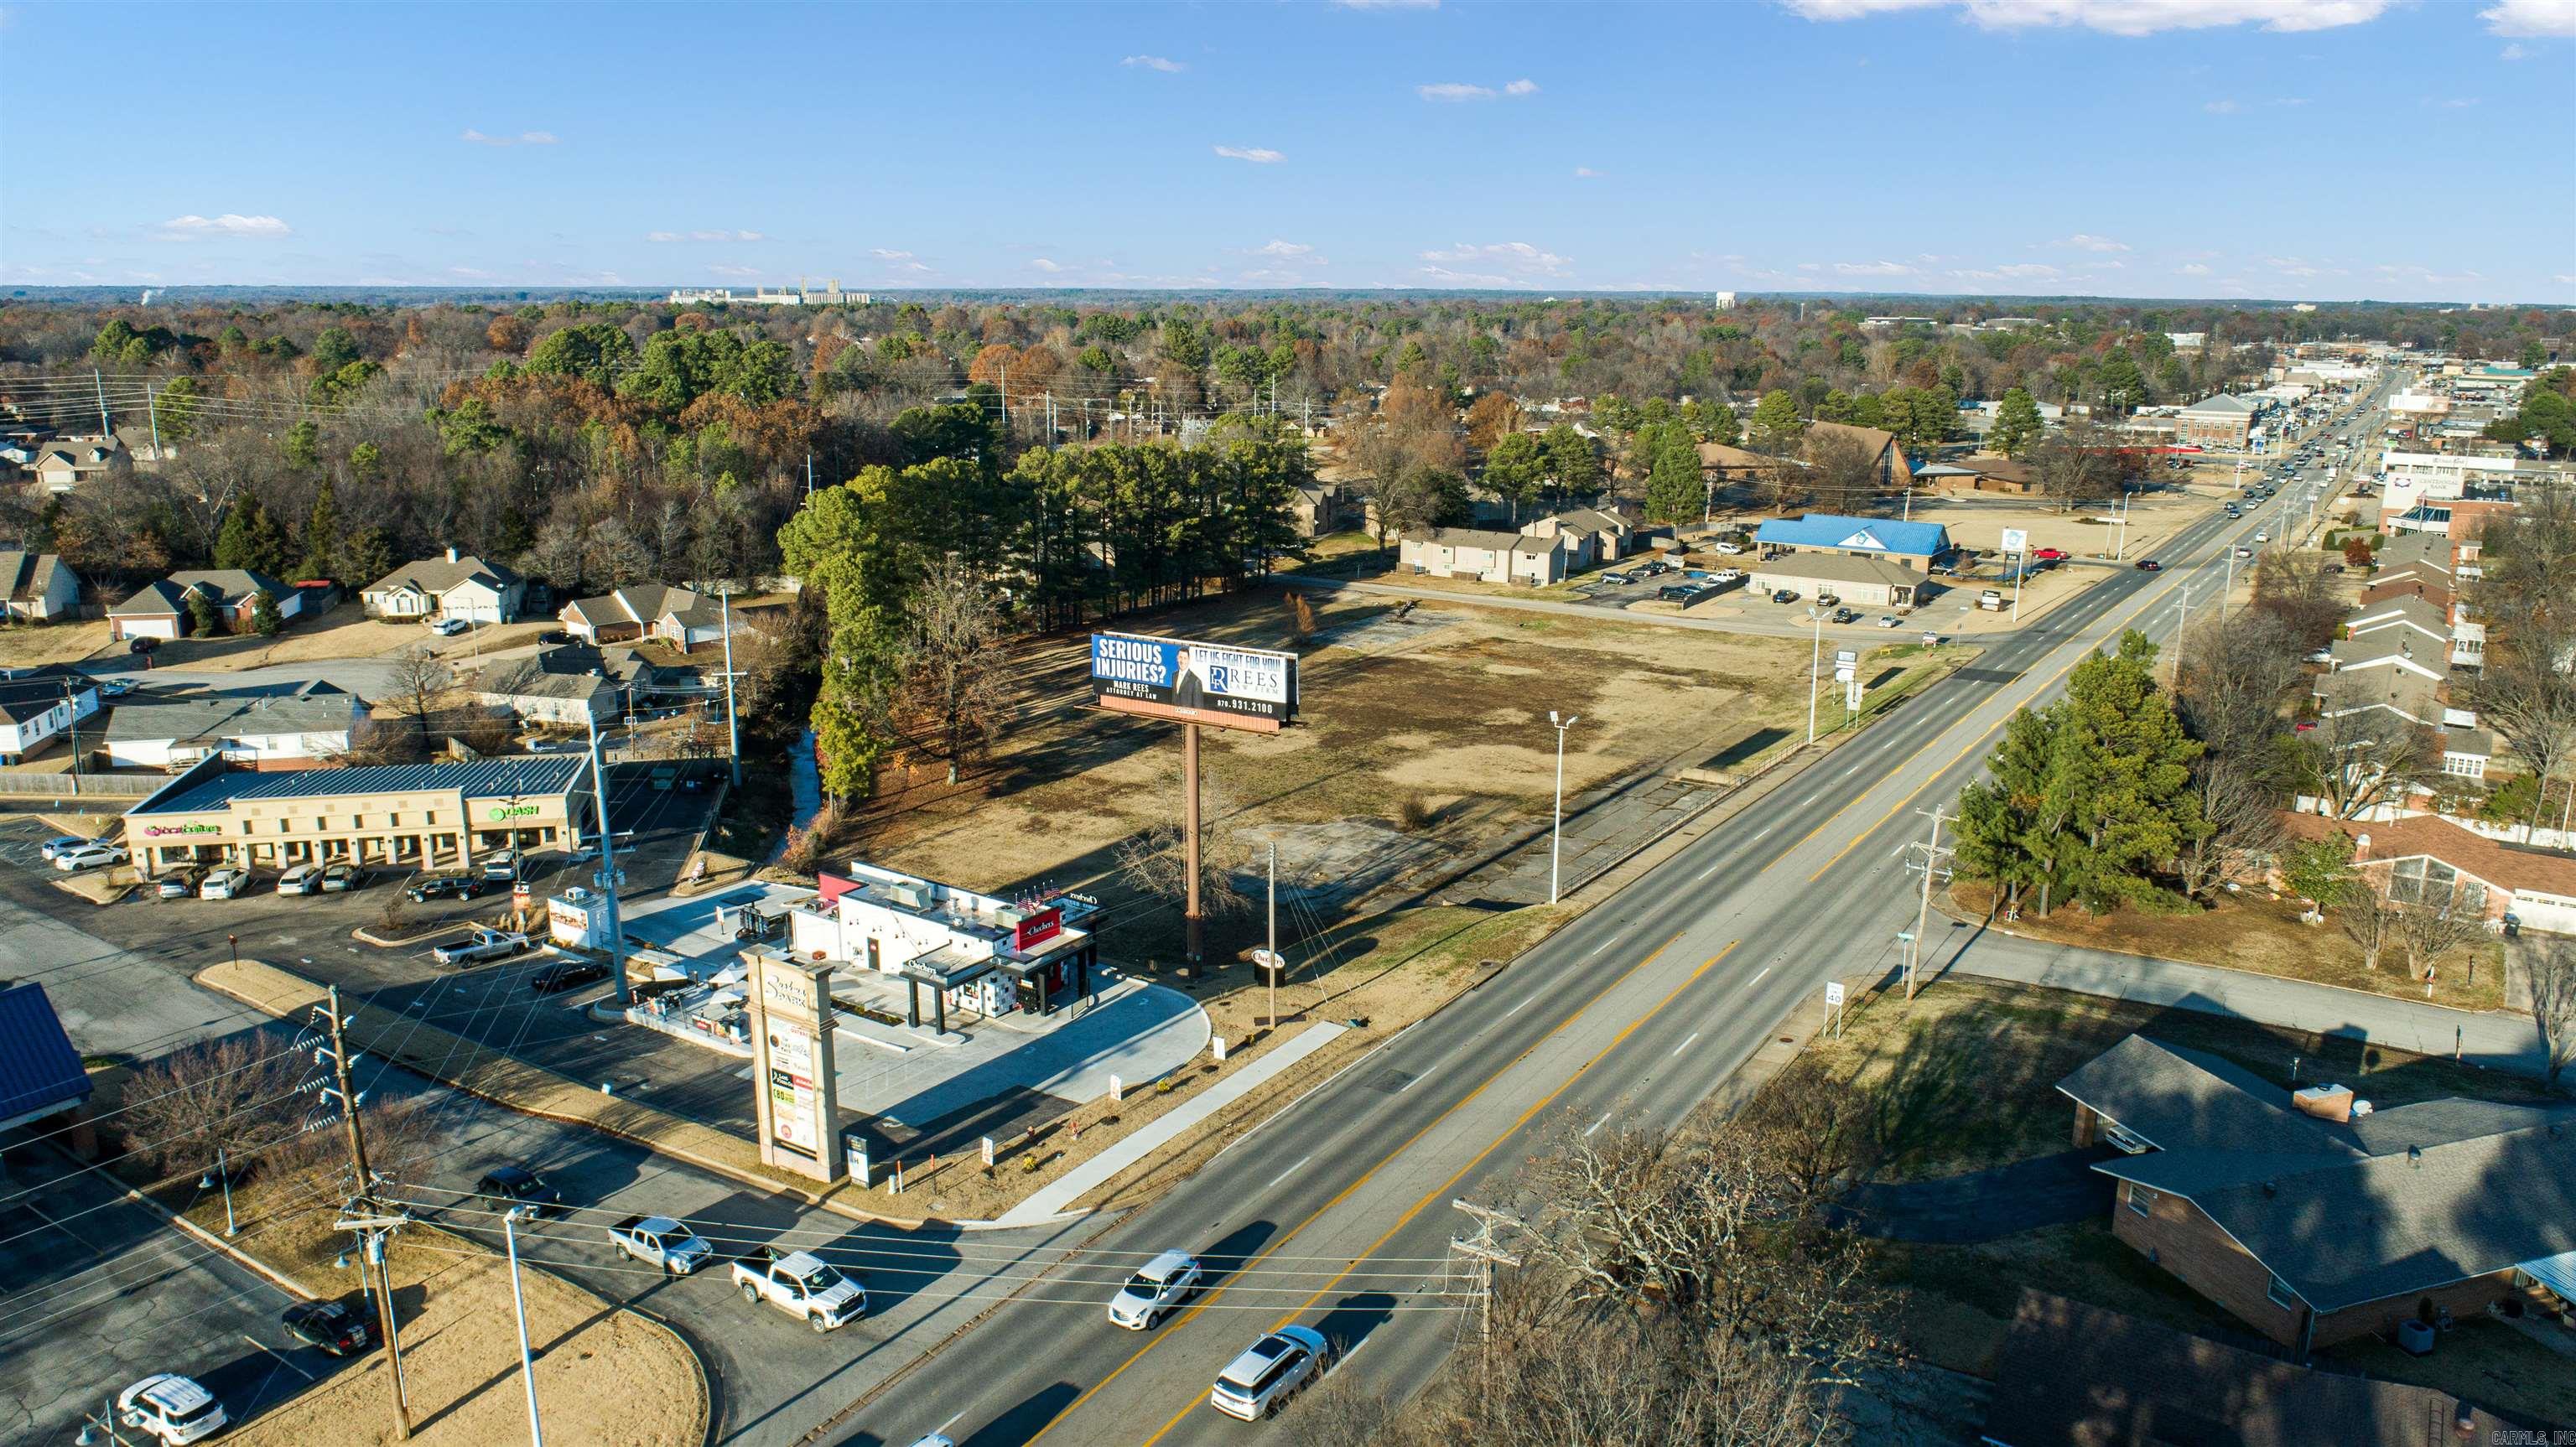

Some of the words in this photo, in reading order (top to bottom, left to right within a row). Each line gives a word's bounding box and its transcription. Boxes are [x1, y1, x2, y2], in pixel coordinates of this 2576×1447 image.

[1098, 638, 1162, 665] SERIOUS
[1195, 649, 1208, 663] LET
[1210, 651, 1219, 665] US
[1222, 652, 1243, 667] FIGHT
[1245, 655, 1260, 670] FOR
[1095, 657, 1166, 684] INJURIES?
[1230, 668, 1277, 688] REES
[1106, 687, 1134, 697] ATTORNEY
[1113, 680, 1131, 690] MARK
[1132, 682, 1150, 692] REES
[1254, 687, 1279, 695] FIRM
[1027, 921, 1054, 936] Checkers
[908, 960, 937, 974] Checkers
[1828, 994, 1841, 1003] 40
